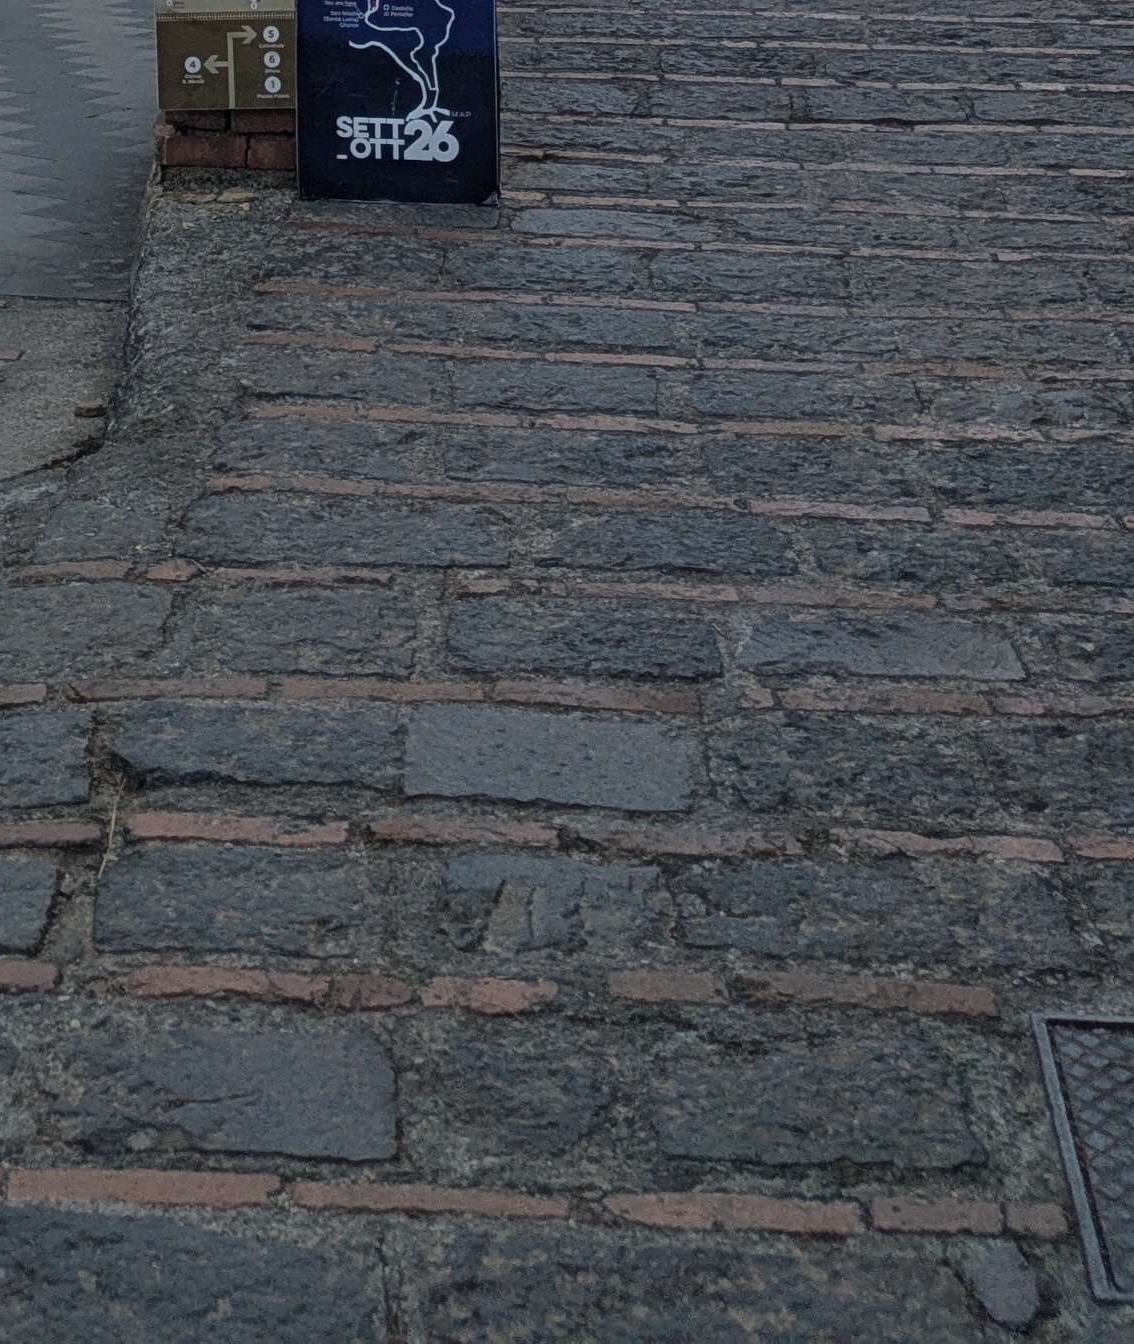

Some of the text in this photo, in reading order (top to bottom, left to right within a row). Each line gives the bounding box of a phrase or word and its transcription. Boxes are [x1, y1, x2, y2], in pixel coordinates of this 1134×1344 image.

[268, 29, 275, 39] 5
[269, 55, 276, 64] 6
[189, 60, 197, 69] 4
[270, 80, 275, 89] 1
[336, 116, 460, 163] SETT 26
